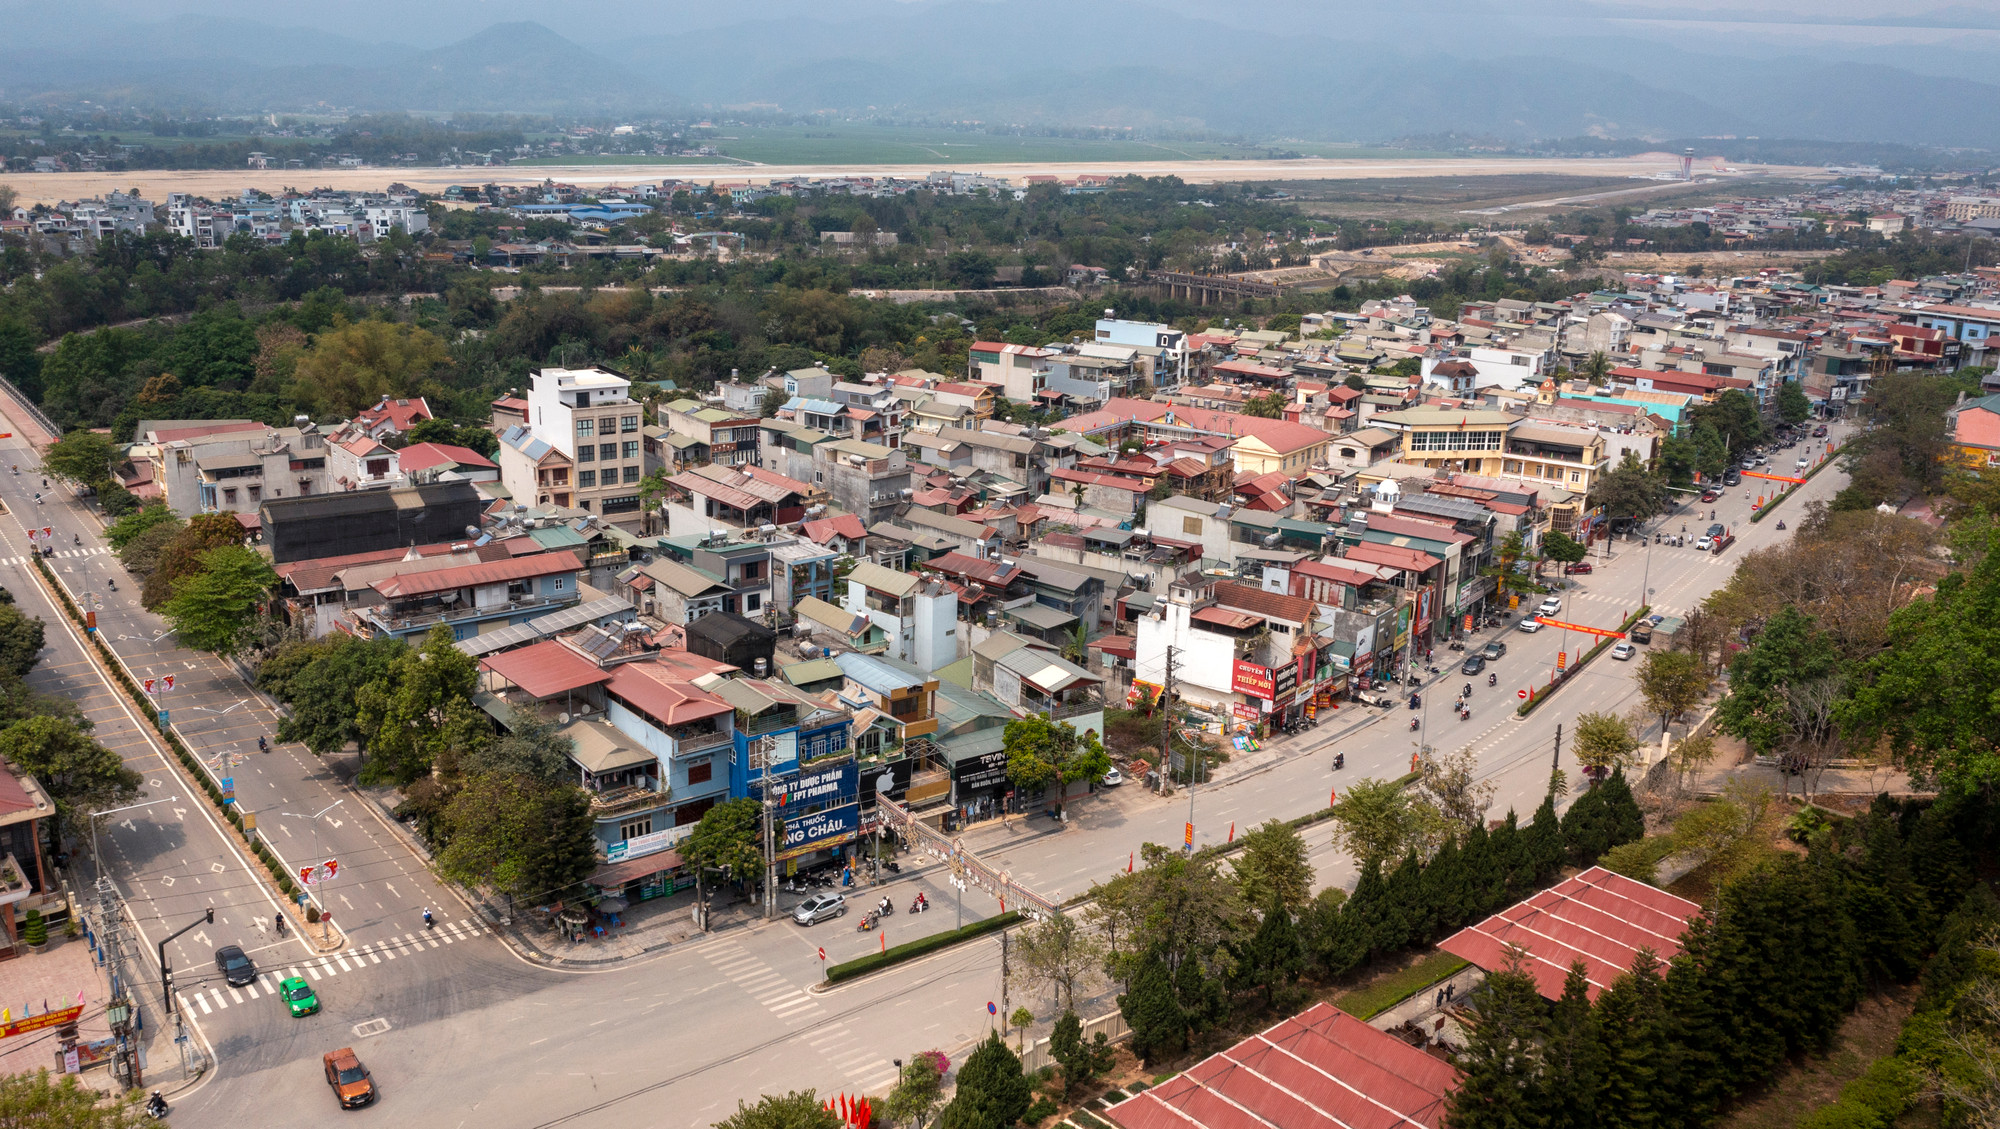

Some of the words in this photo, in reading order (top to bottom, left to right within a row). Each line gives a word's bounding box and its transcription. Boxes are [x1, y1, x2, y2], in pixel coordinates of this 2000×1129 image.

[1239, 664, 1263, 675] CHUYÊN
[1237, 675, 1257, 686] THIẾP
[1258, 680, 1271, 690] MỜI
[789, 780, 799, 792] TY
[800, 776, 820, 789] DƯỢC
[821, 769, 843, 784] PHẨM
[794, 790, 807, 801] FPT
[808, 782, 838, 798] PHARMA
[802, 814, 826, 826] THUỐC
[808, 819, 843, 838] CHÂU
